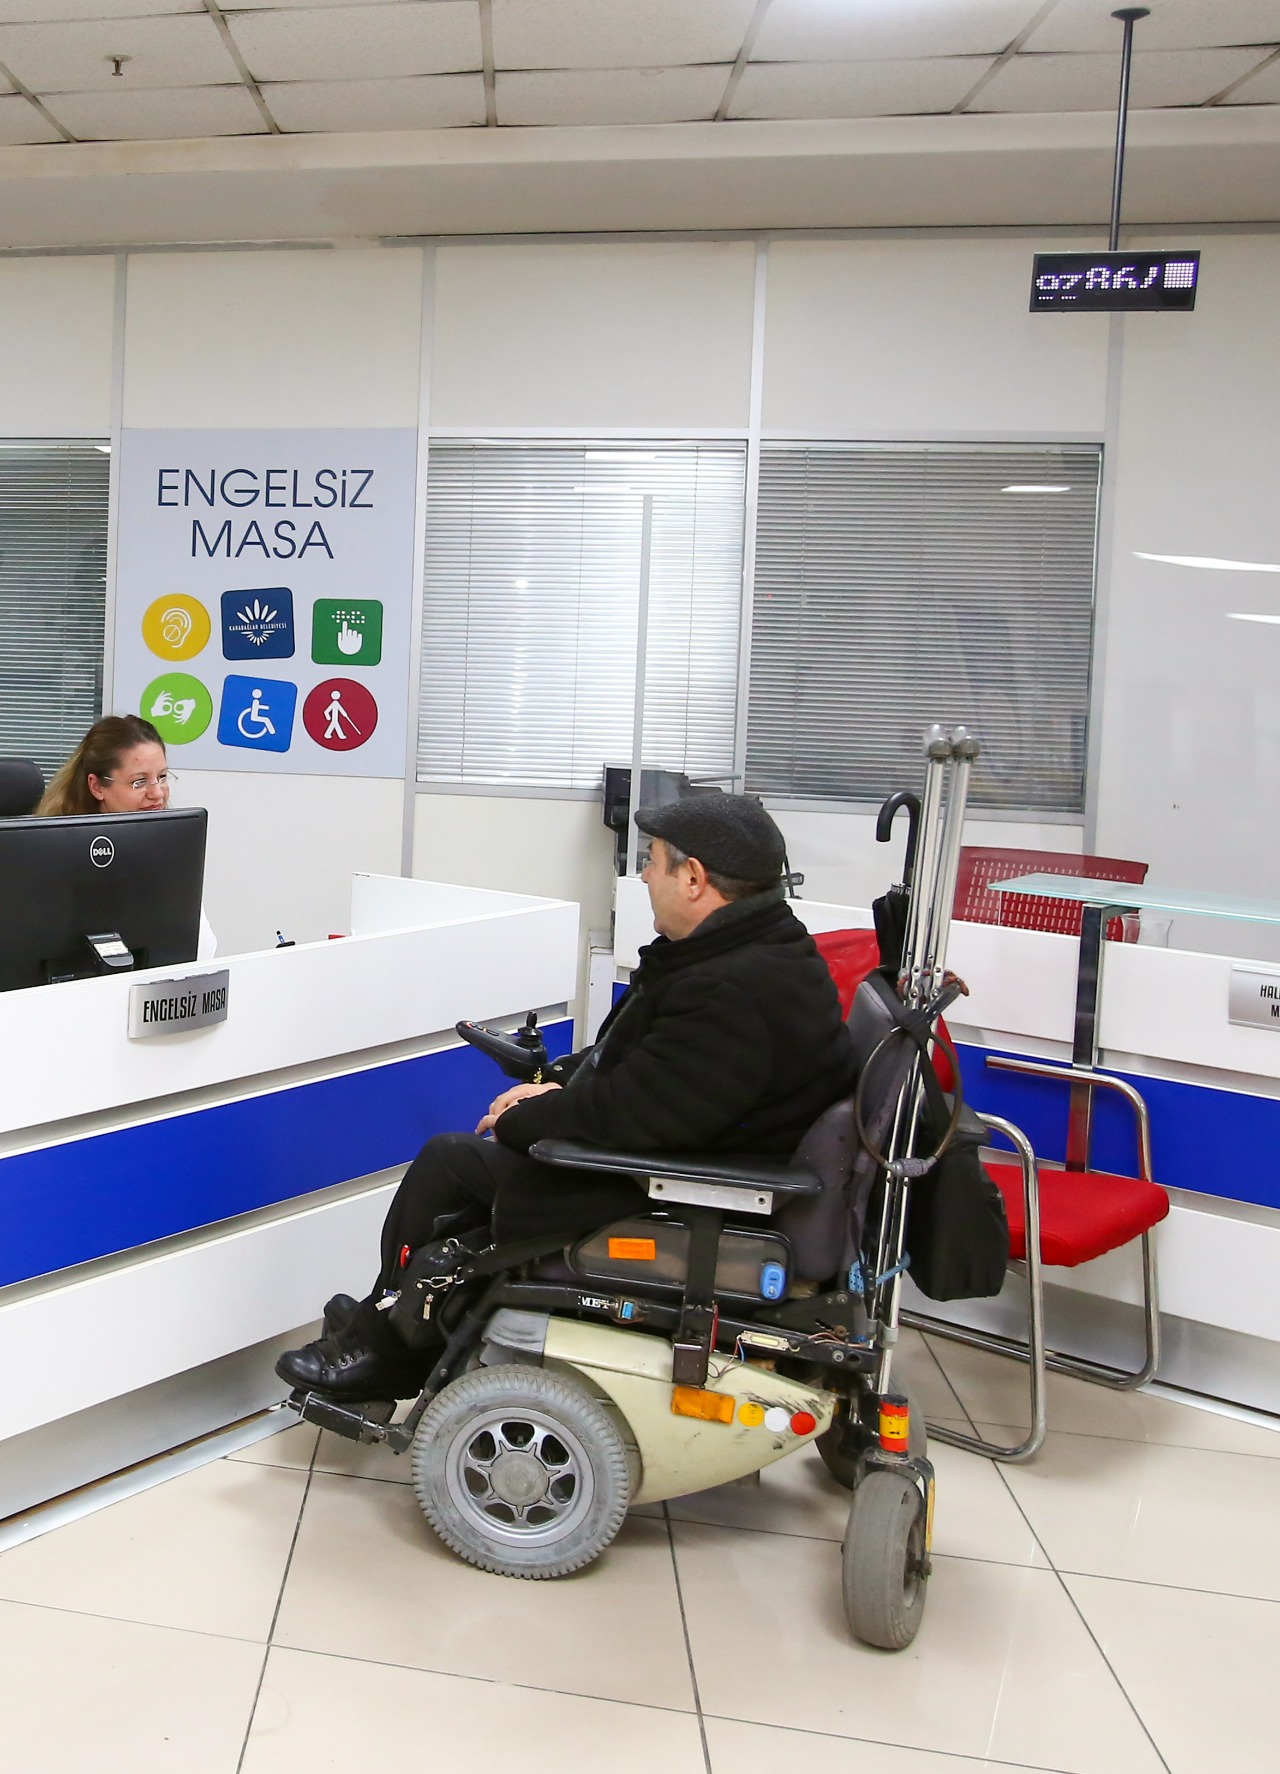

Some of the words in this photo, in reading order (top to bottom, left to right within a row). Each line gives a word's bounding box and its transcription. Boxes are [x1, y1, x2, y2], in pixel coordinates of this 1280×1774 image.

[191, 519, 334, 559] MASA
[93, 848, 112, 857] DELL
[143, 991, 198, 1023] ENGELSİZ
[202, 987, 226, 1015] MASA
[1260, 985, 1280, 1000] HAL
